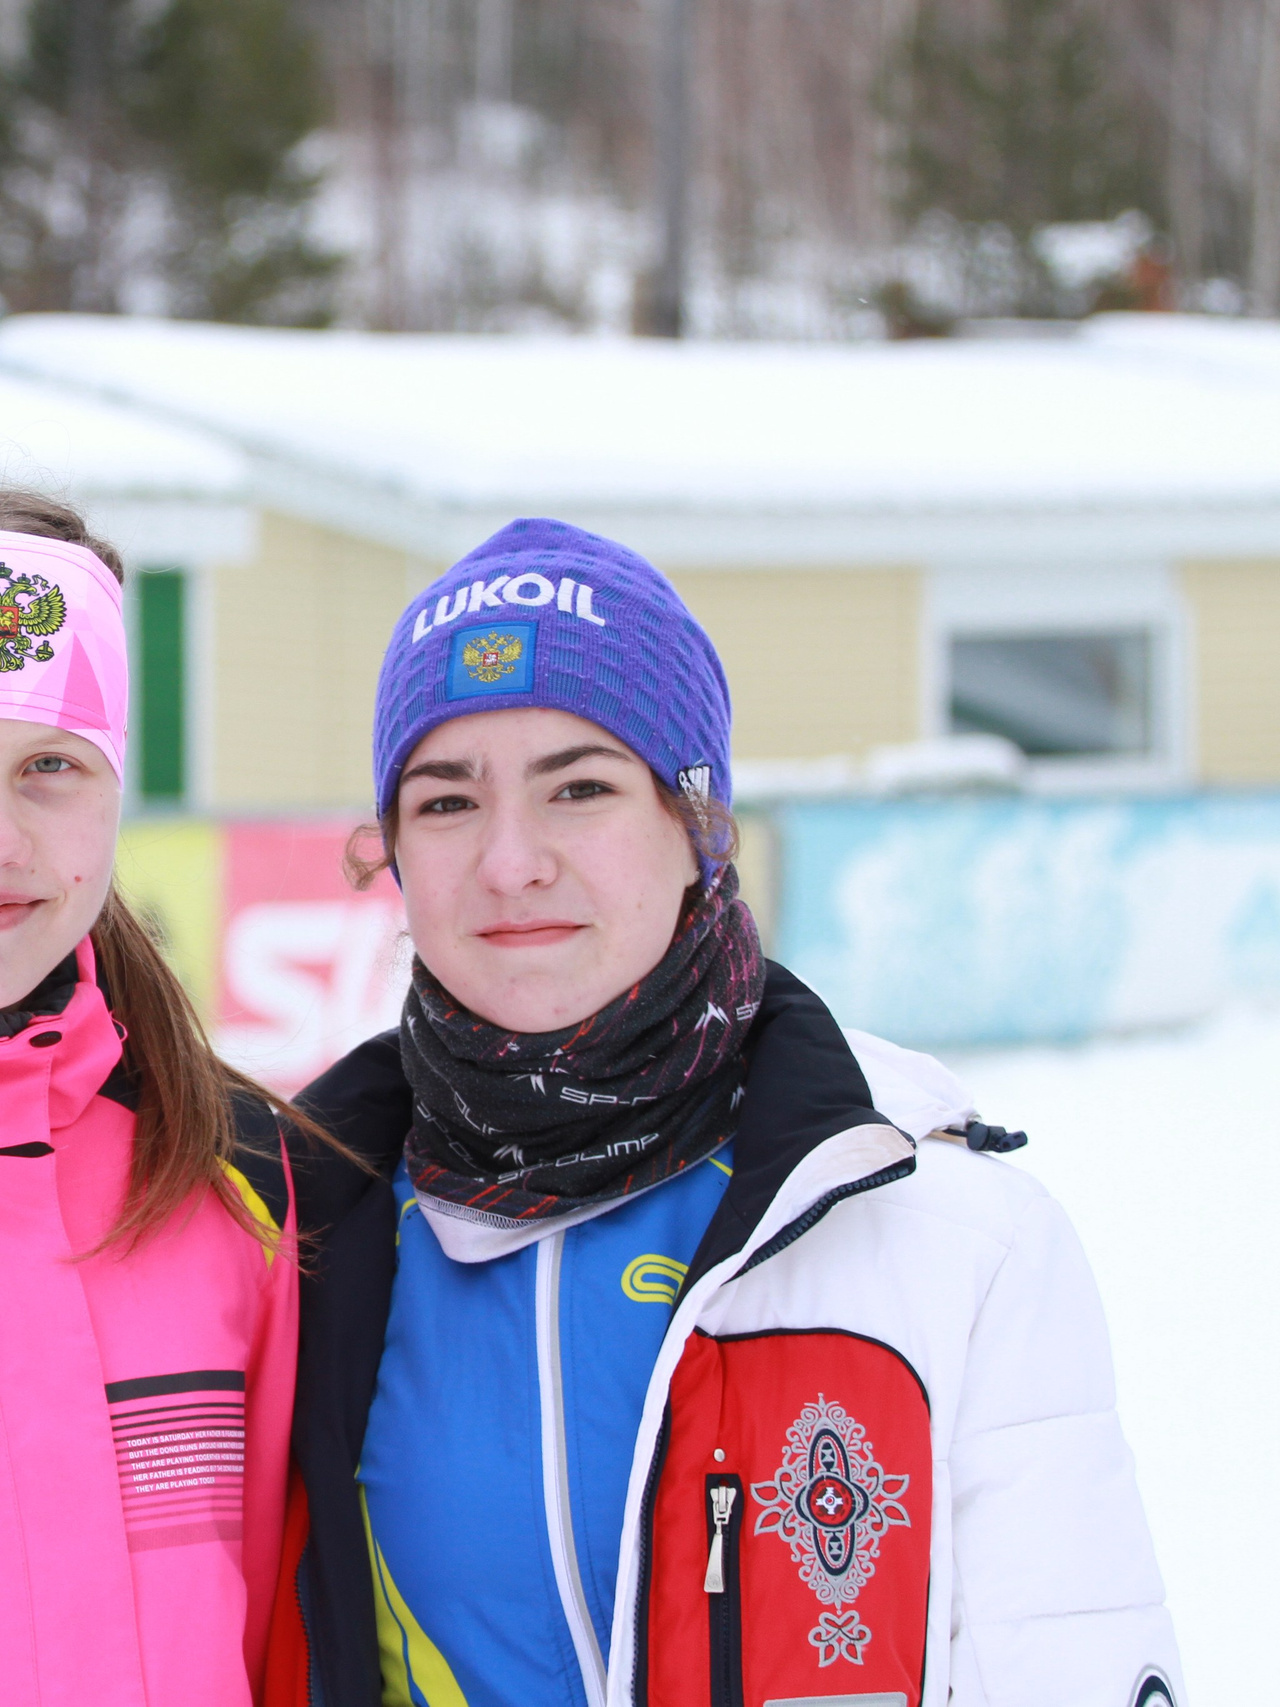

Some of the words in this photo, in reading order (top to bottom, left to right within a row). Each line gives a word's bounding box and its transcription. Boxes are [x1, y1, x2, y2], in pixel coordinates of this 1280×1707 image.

[412, 573, 605, 644] LUKOIL
[126, 1438, 151, 1448] TODAY
[152, 1436, 159, 1444] IS
[160, 1431, 194, 1443] SATURDAY
[129, 1450, 144, 1459] BUT
[145, 1448, 159, 1457] THE
[180, 1443, 198, 1452] RUNS
[131, 1461, 150, 1470] THEY
[151, 1459, 165, 1468] ARE
[166, 1455, 194, 1466] PLAYING
[133, 1473, 148, 1482] HER
[149, 1469, 175, 1480] FATHER
[176, 1468, 183, 1476] IS
[135, 1484, 154, 1493] THEY
[155, 1482, 169, 1491] ARE
[170, 1478, 198, 1489] PLAYING
